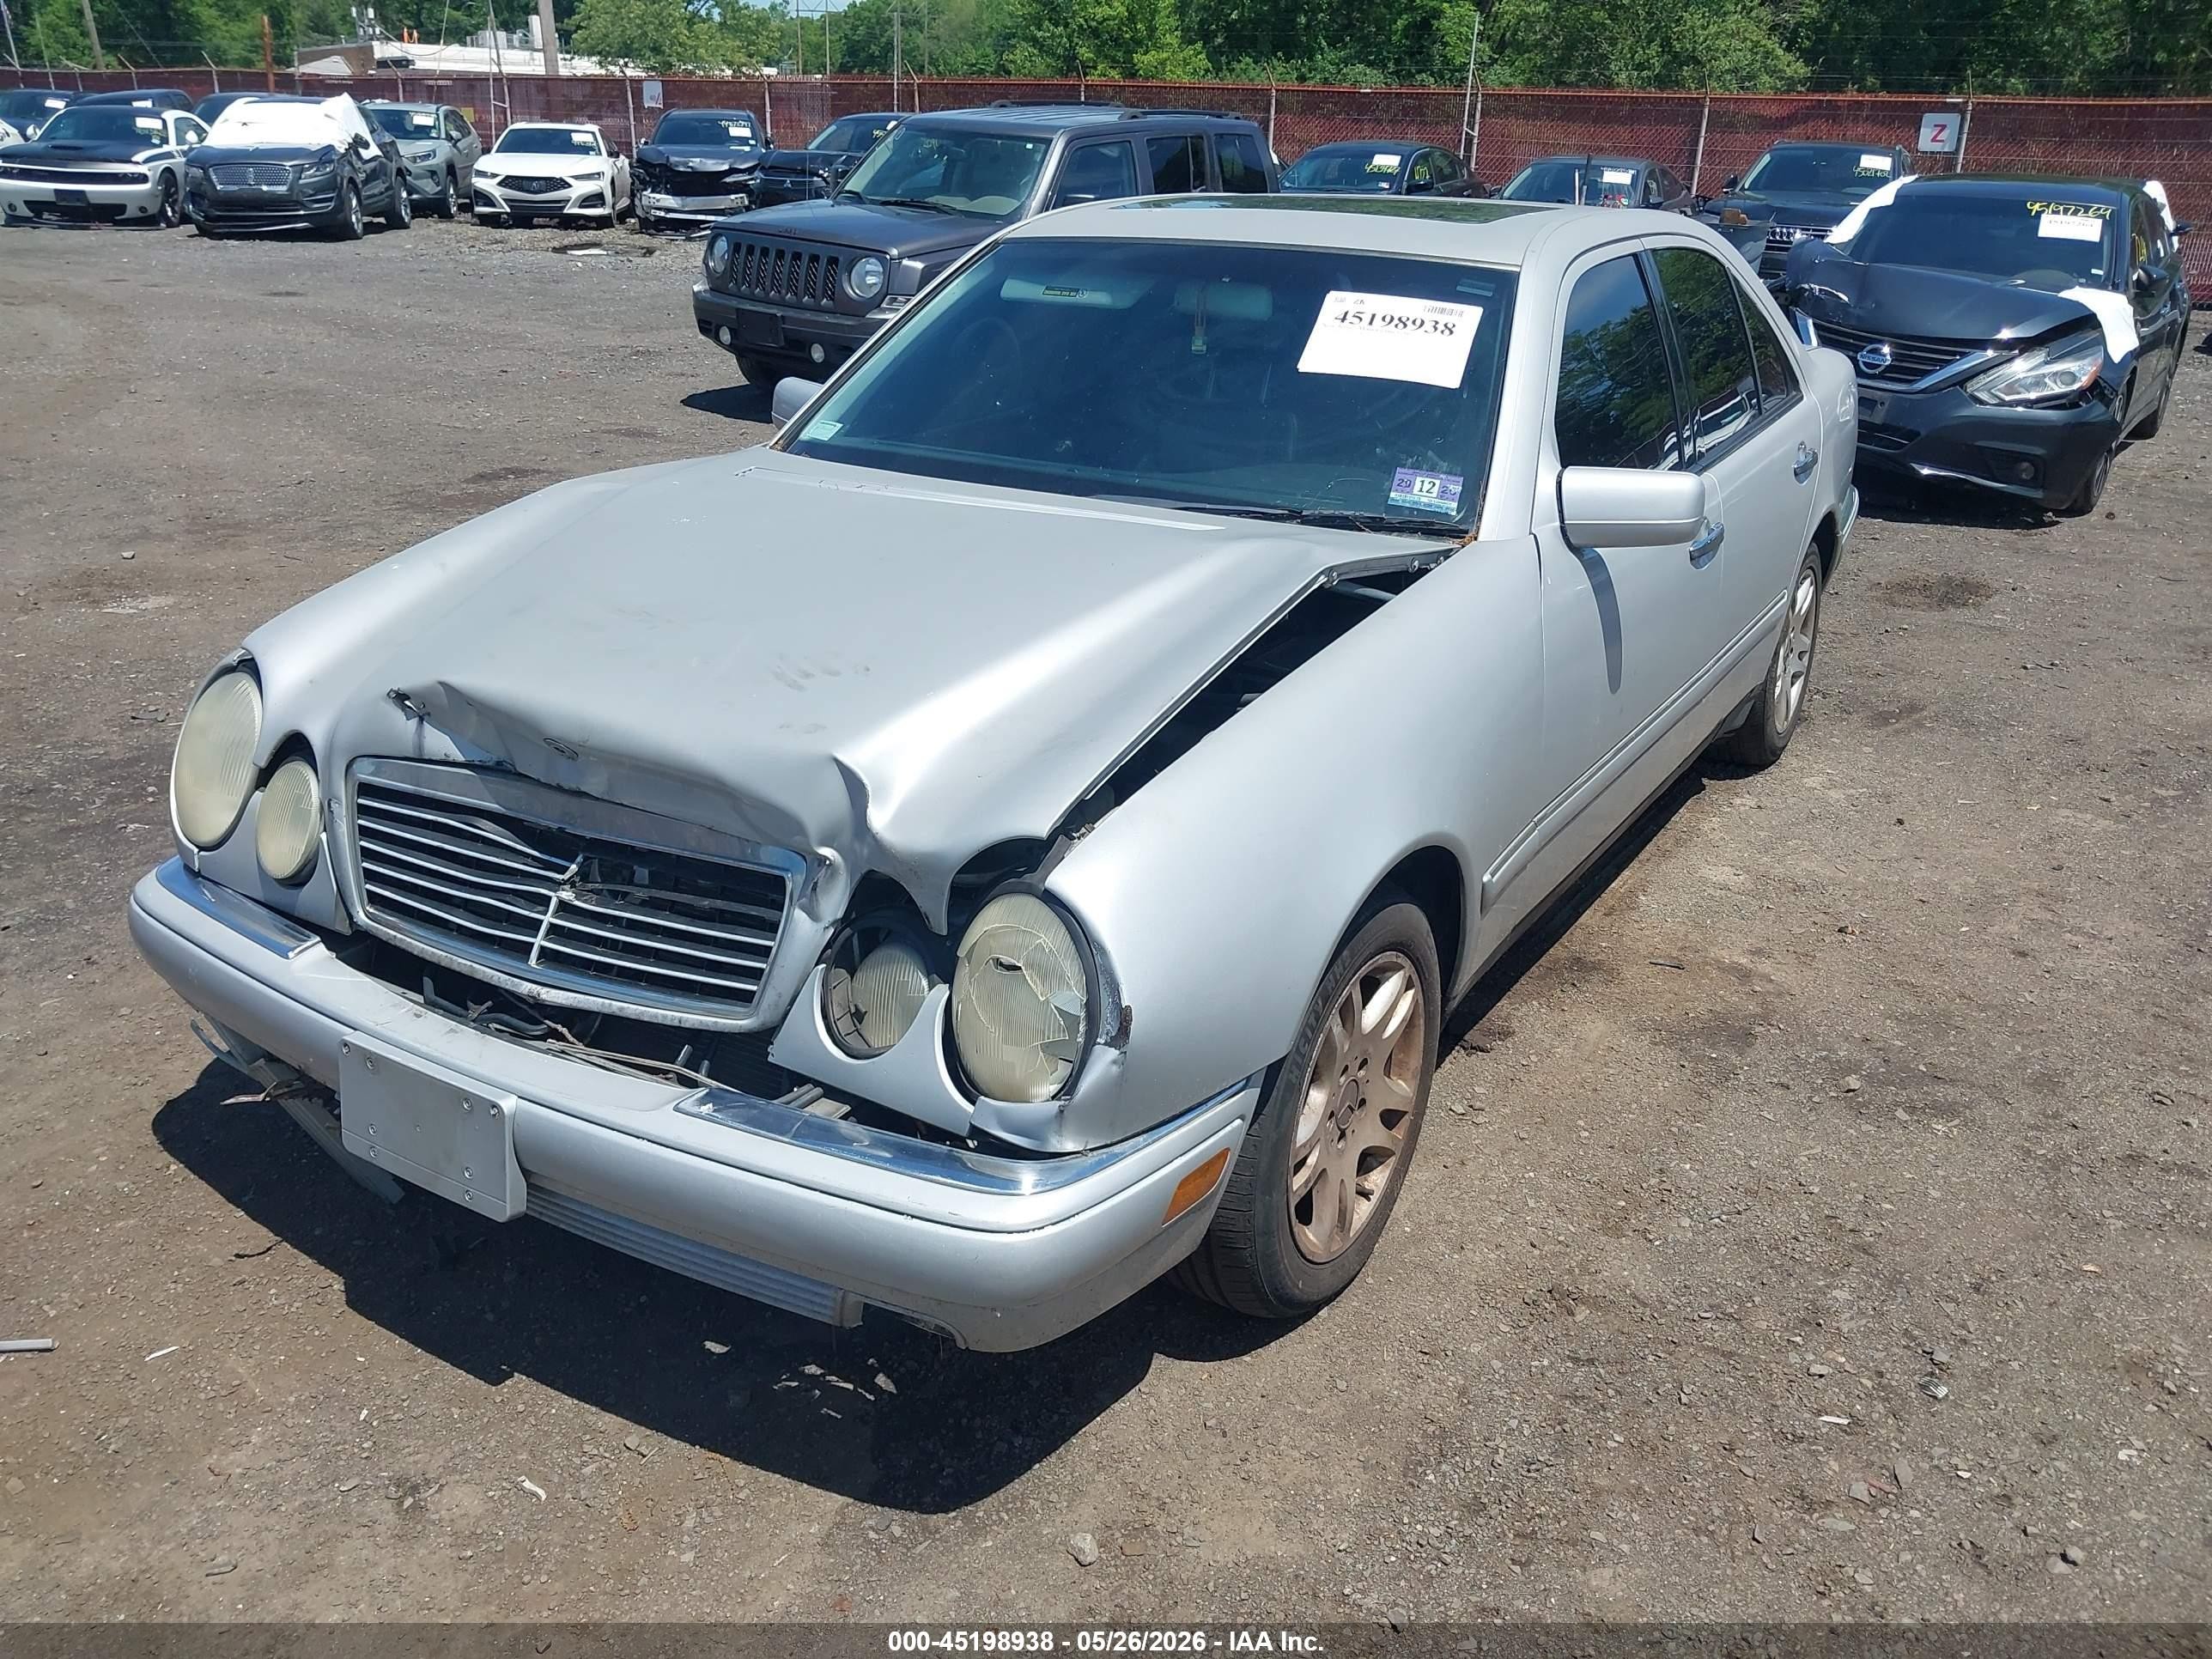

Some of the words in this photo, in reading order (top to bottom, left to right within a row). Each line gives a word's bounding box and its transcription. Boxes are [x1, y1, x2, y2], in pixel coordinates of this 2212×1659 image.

[1930, 124, 1948, 143] Z
[1334, 309, 1457, 337] 45198938
[1859, 353, 1887, 364] NISSAN
[1417, 479, 1437, 495] 12
